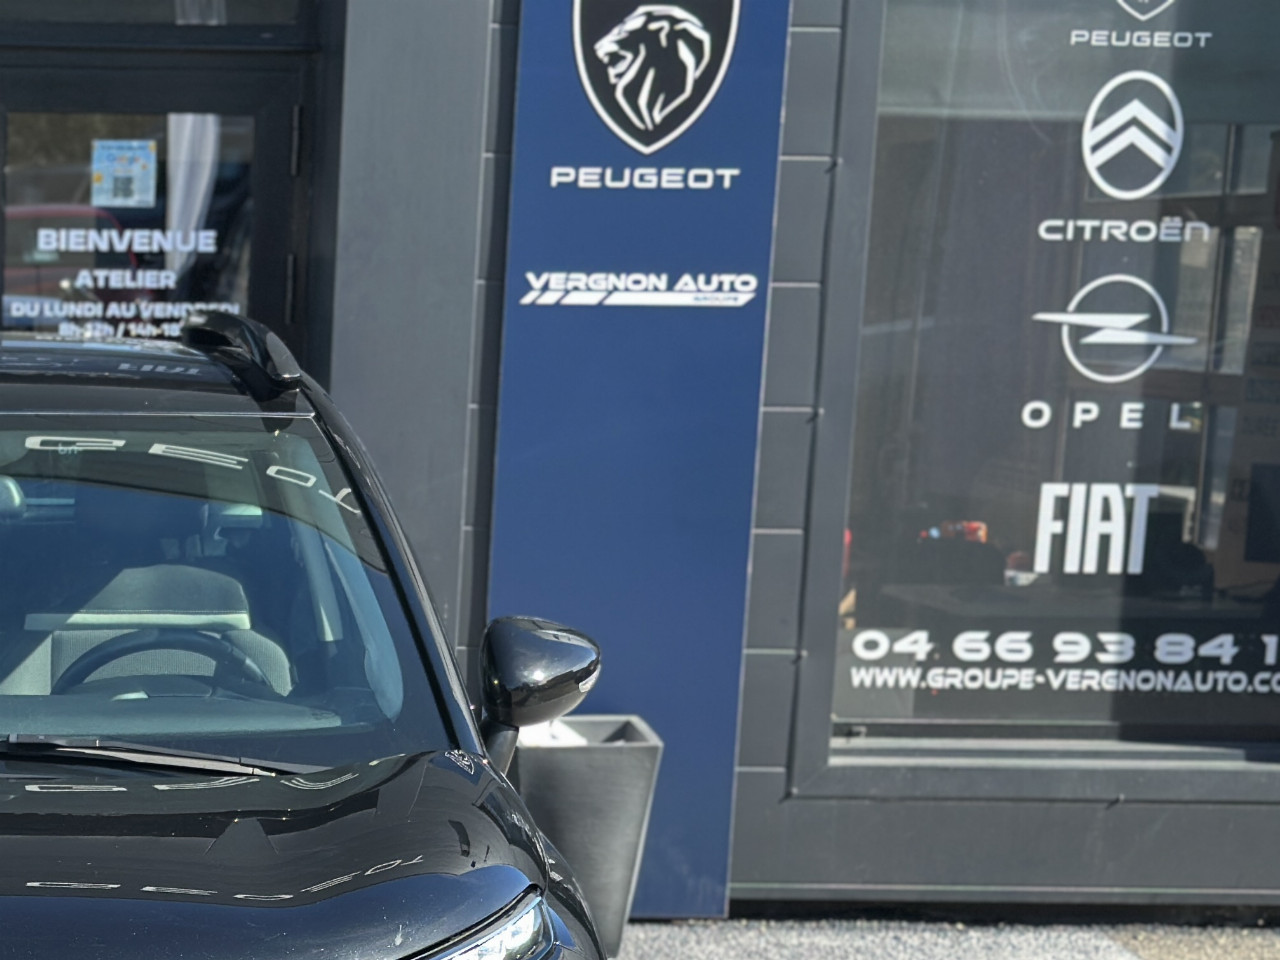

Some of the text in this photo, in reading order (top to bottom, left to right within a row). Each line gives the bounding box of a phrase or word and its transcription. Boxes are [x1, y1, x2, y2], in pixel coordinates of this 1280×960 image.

[1070, 30, 1213, 48] PEUGEOT
[550, 166, 741, 189] PEUGEOT
[36, 228, 218, 253] BIENVENUE
[74, 269, 177, 290] ATELIER
[525, 272, 759, 292] VERGNON AUTO
[10, 301, 41, 318] DU
[44, 302, 104, 319] LUNDI
[106, 302, 137, 319] AU
[1033, 482, 1160, 575] FIAT
[852, 629, 935, 662] 04
[952, 630, 1034, 662] 66
[1052, 631, 1136, 664] 93
[1154, 632, 1240, 666] 84
